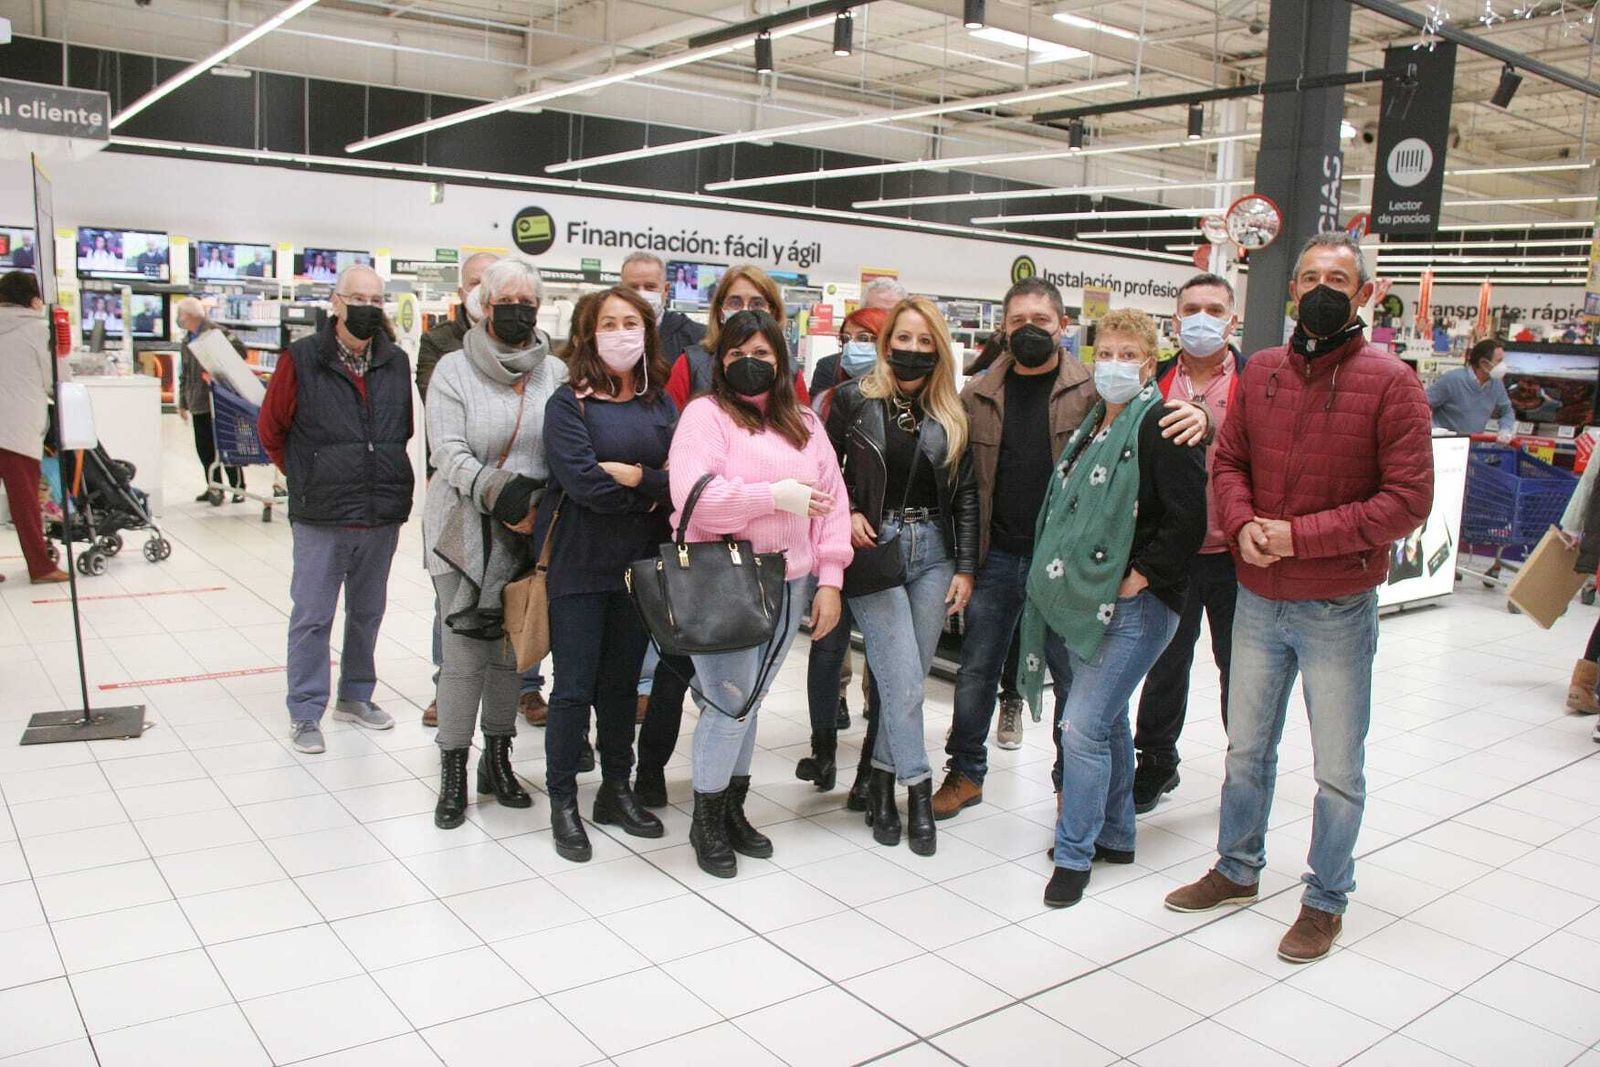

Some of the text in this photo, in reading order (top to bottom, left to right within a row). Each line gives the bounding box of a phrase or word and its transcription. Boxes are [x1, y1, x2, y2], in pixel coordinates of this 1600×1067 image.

[0, 96, 103, 126] l cliente
[1389, 201, 1423, 211] Lector
[1378, 214, 1431, 226] de precios
[567, 221, 821, 269] Financiación: fácil y ágil
[1043, 268, 1182, 298] Instalación profesio
[1412, 301, 1527, 320] Tansprte:
